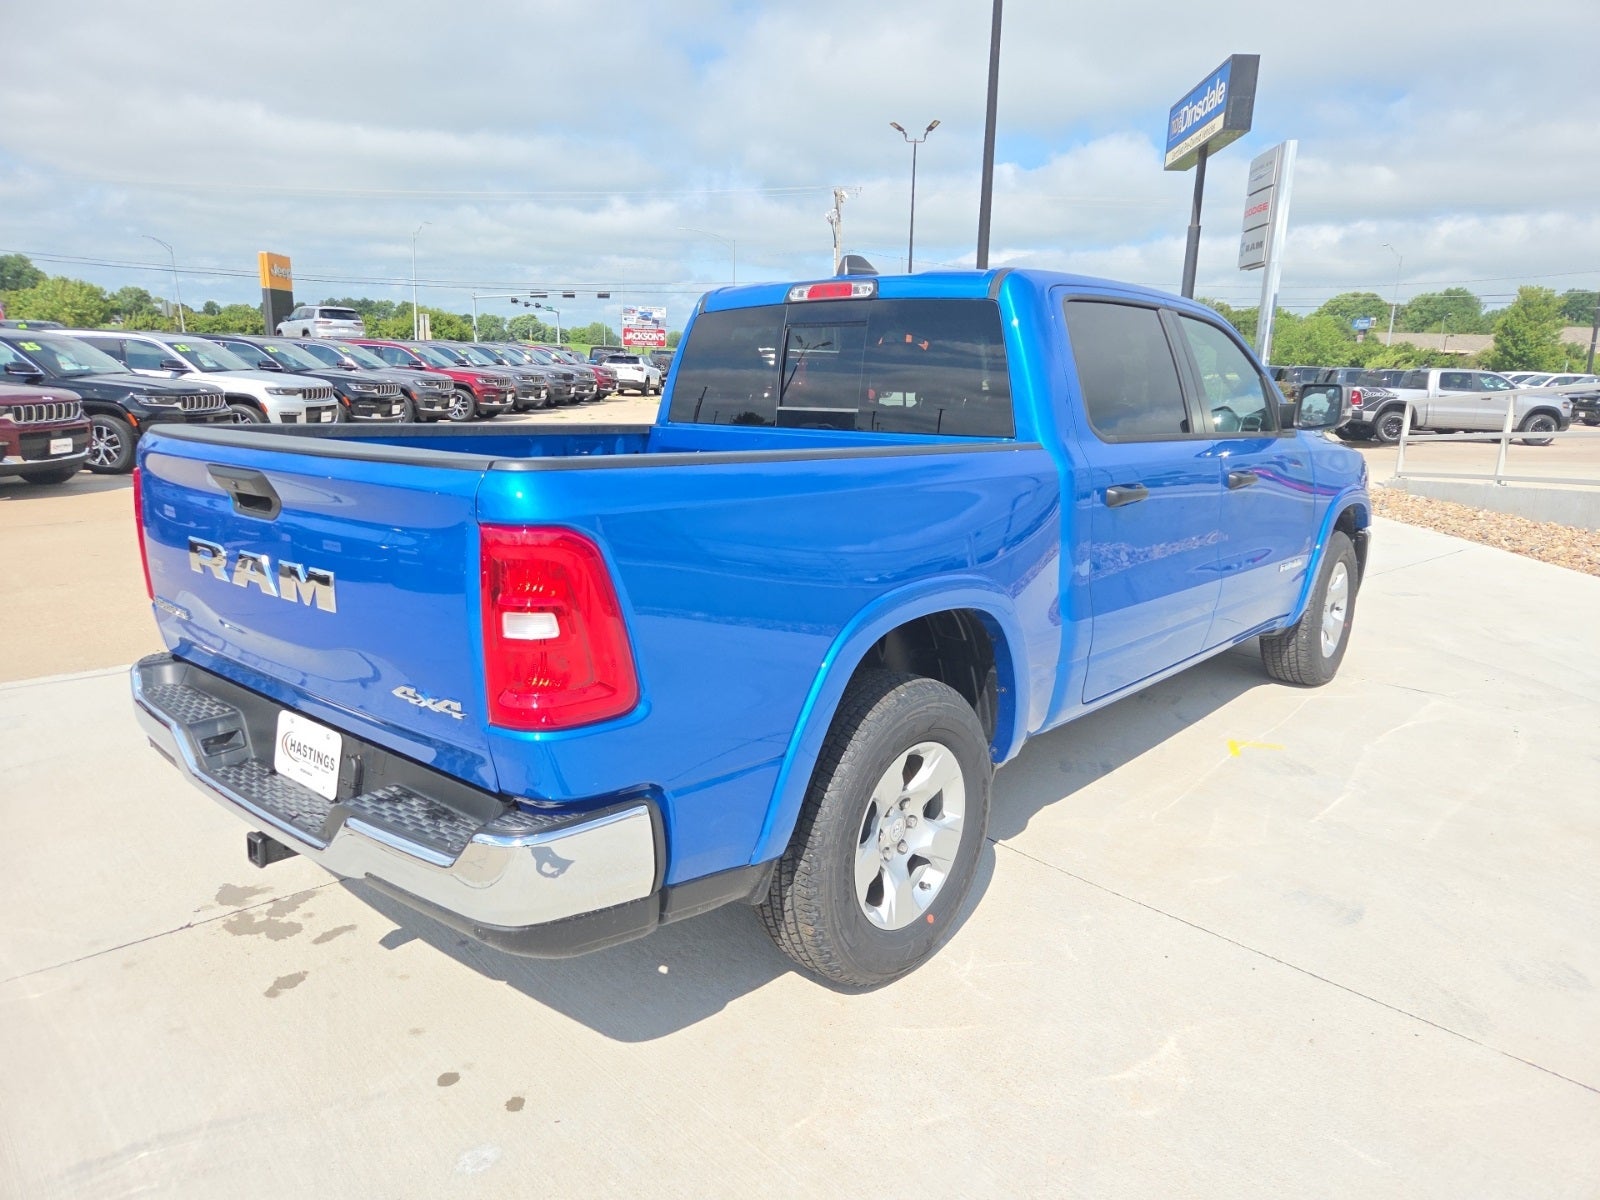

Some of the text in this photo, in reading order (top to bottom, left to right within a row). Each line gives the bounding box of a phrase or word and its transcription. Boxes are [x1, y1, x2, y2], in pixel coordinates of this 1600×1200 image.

[1180, 78, 1226, 133] Dinsdale
[1244, 201, 1269, 218] DODGE
[1245, 241, 1264, 253] RAM
[188, 535, 337, 614] RAM
[290, 738, 335, 771] HASTINGS
